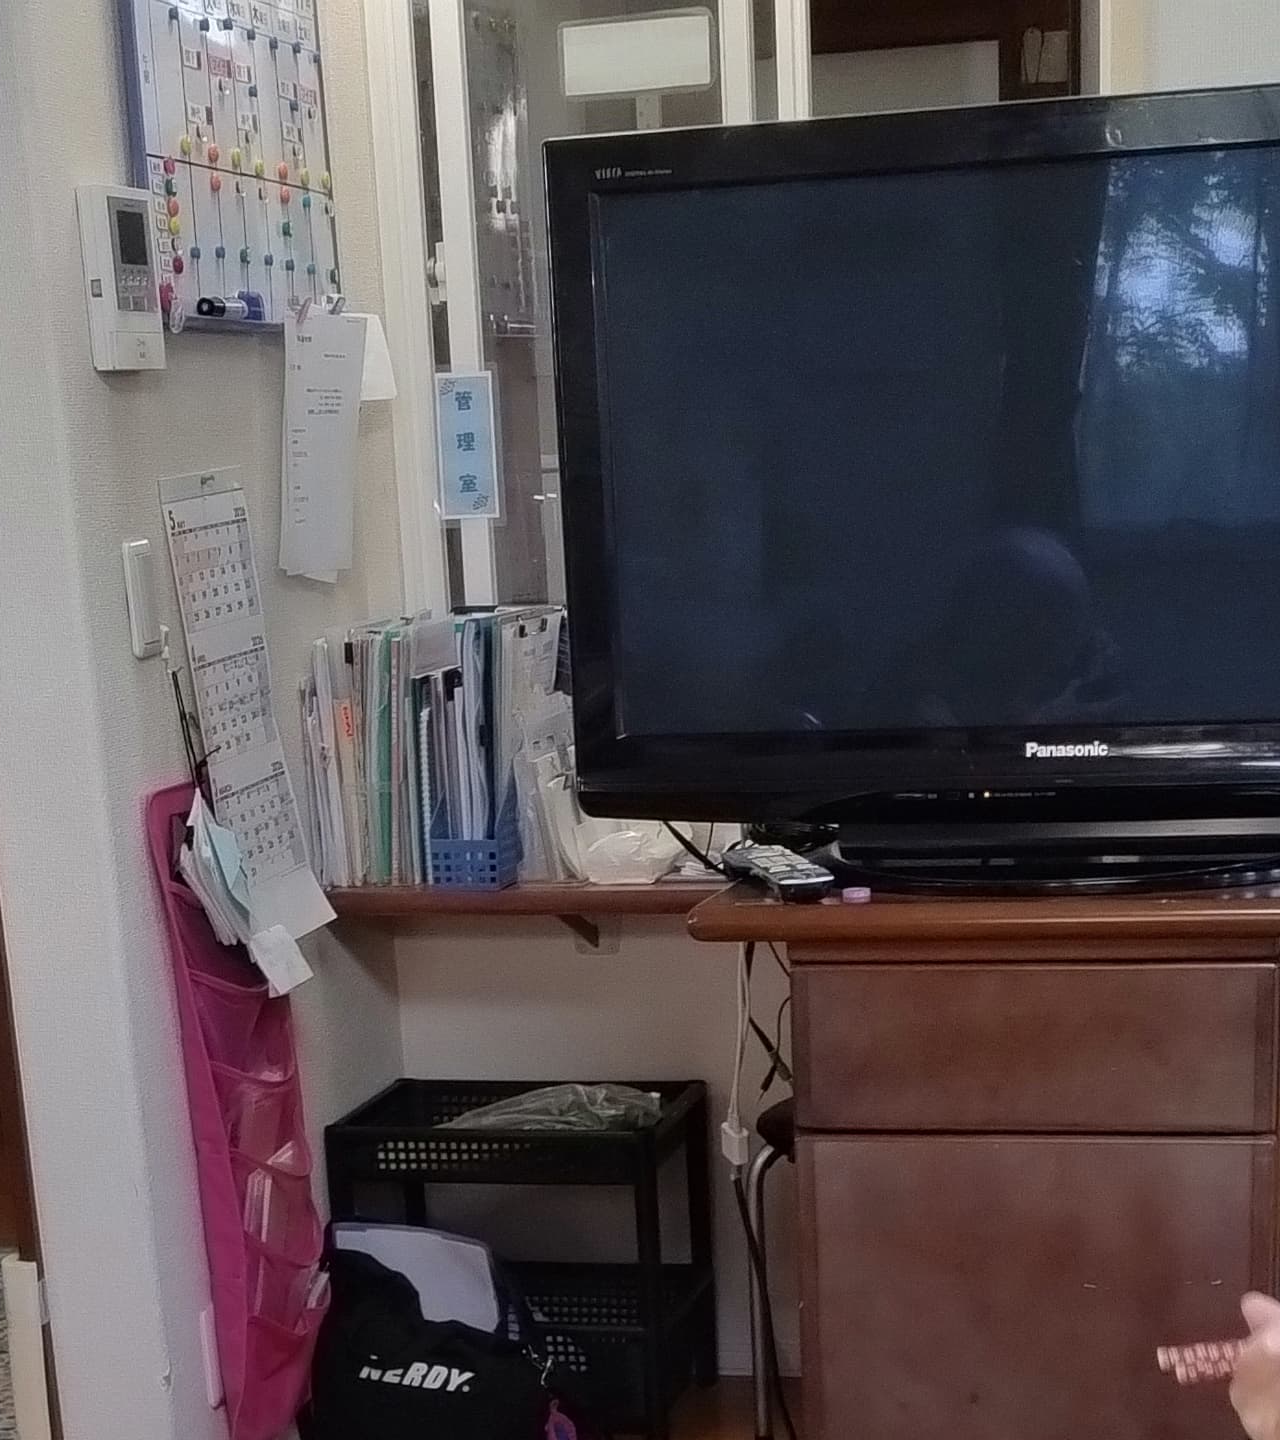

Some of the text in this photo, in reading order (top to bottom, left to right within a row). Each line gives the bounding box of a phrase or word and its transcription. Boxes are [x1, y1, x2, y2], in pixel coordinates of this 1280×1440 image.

[455, 390, 480, 493] 管理室
[1025, 740, 1109, 758] Panasonic
